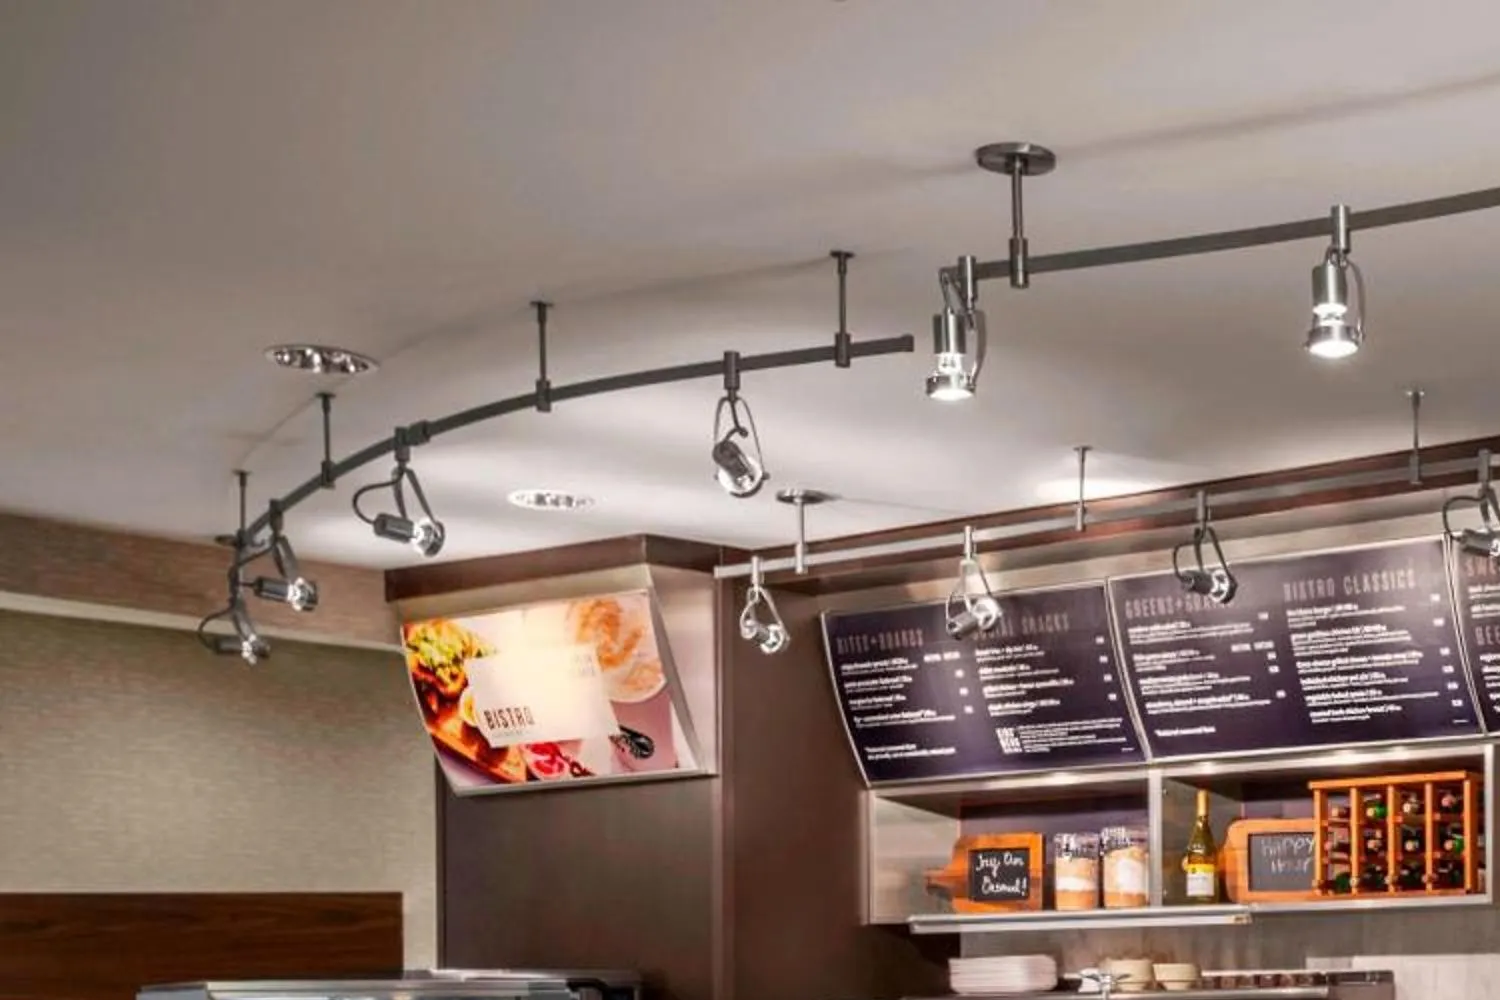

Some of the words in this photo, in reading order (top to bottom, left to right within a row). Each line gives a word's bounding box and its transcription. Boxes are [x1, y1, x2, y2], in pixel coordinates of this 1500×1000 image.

[1283, 577, 1335, 602] BISTRO
[1343, 569, 1416, 594] CLASSICS
[484, 706, 535, 730] BISTRO
